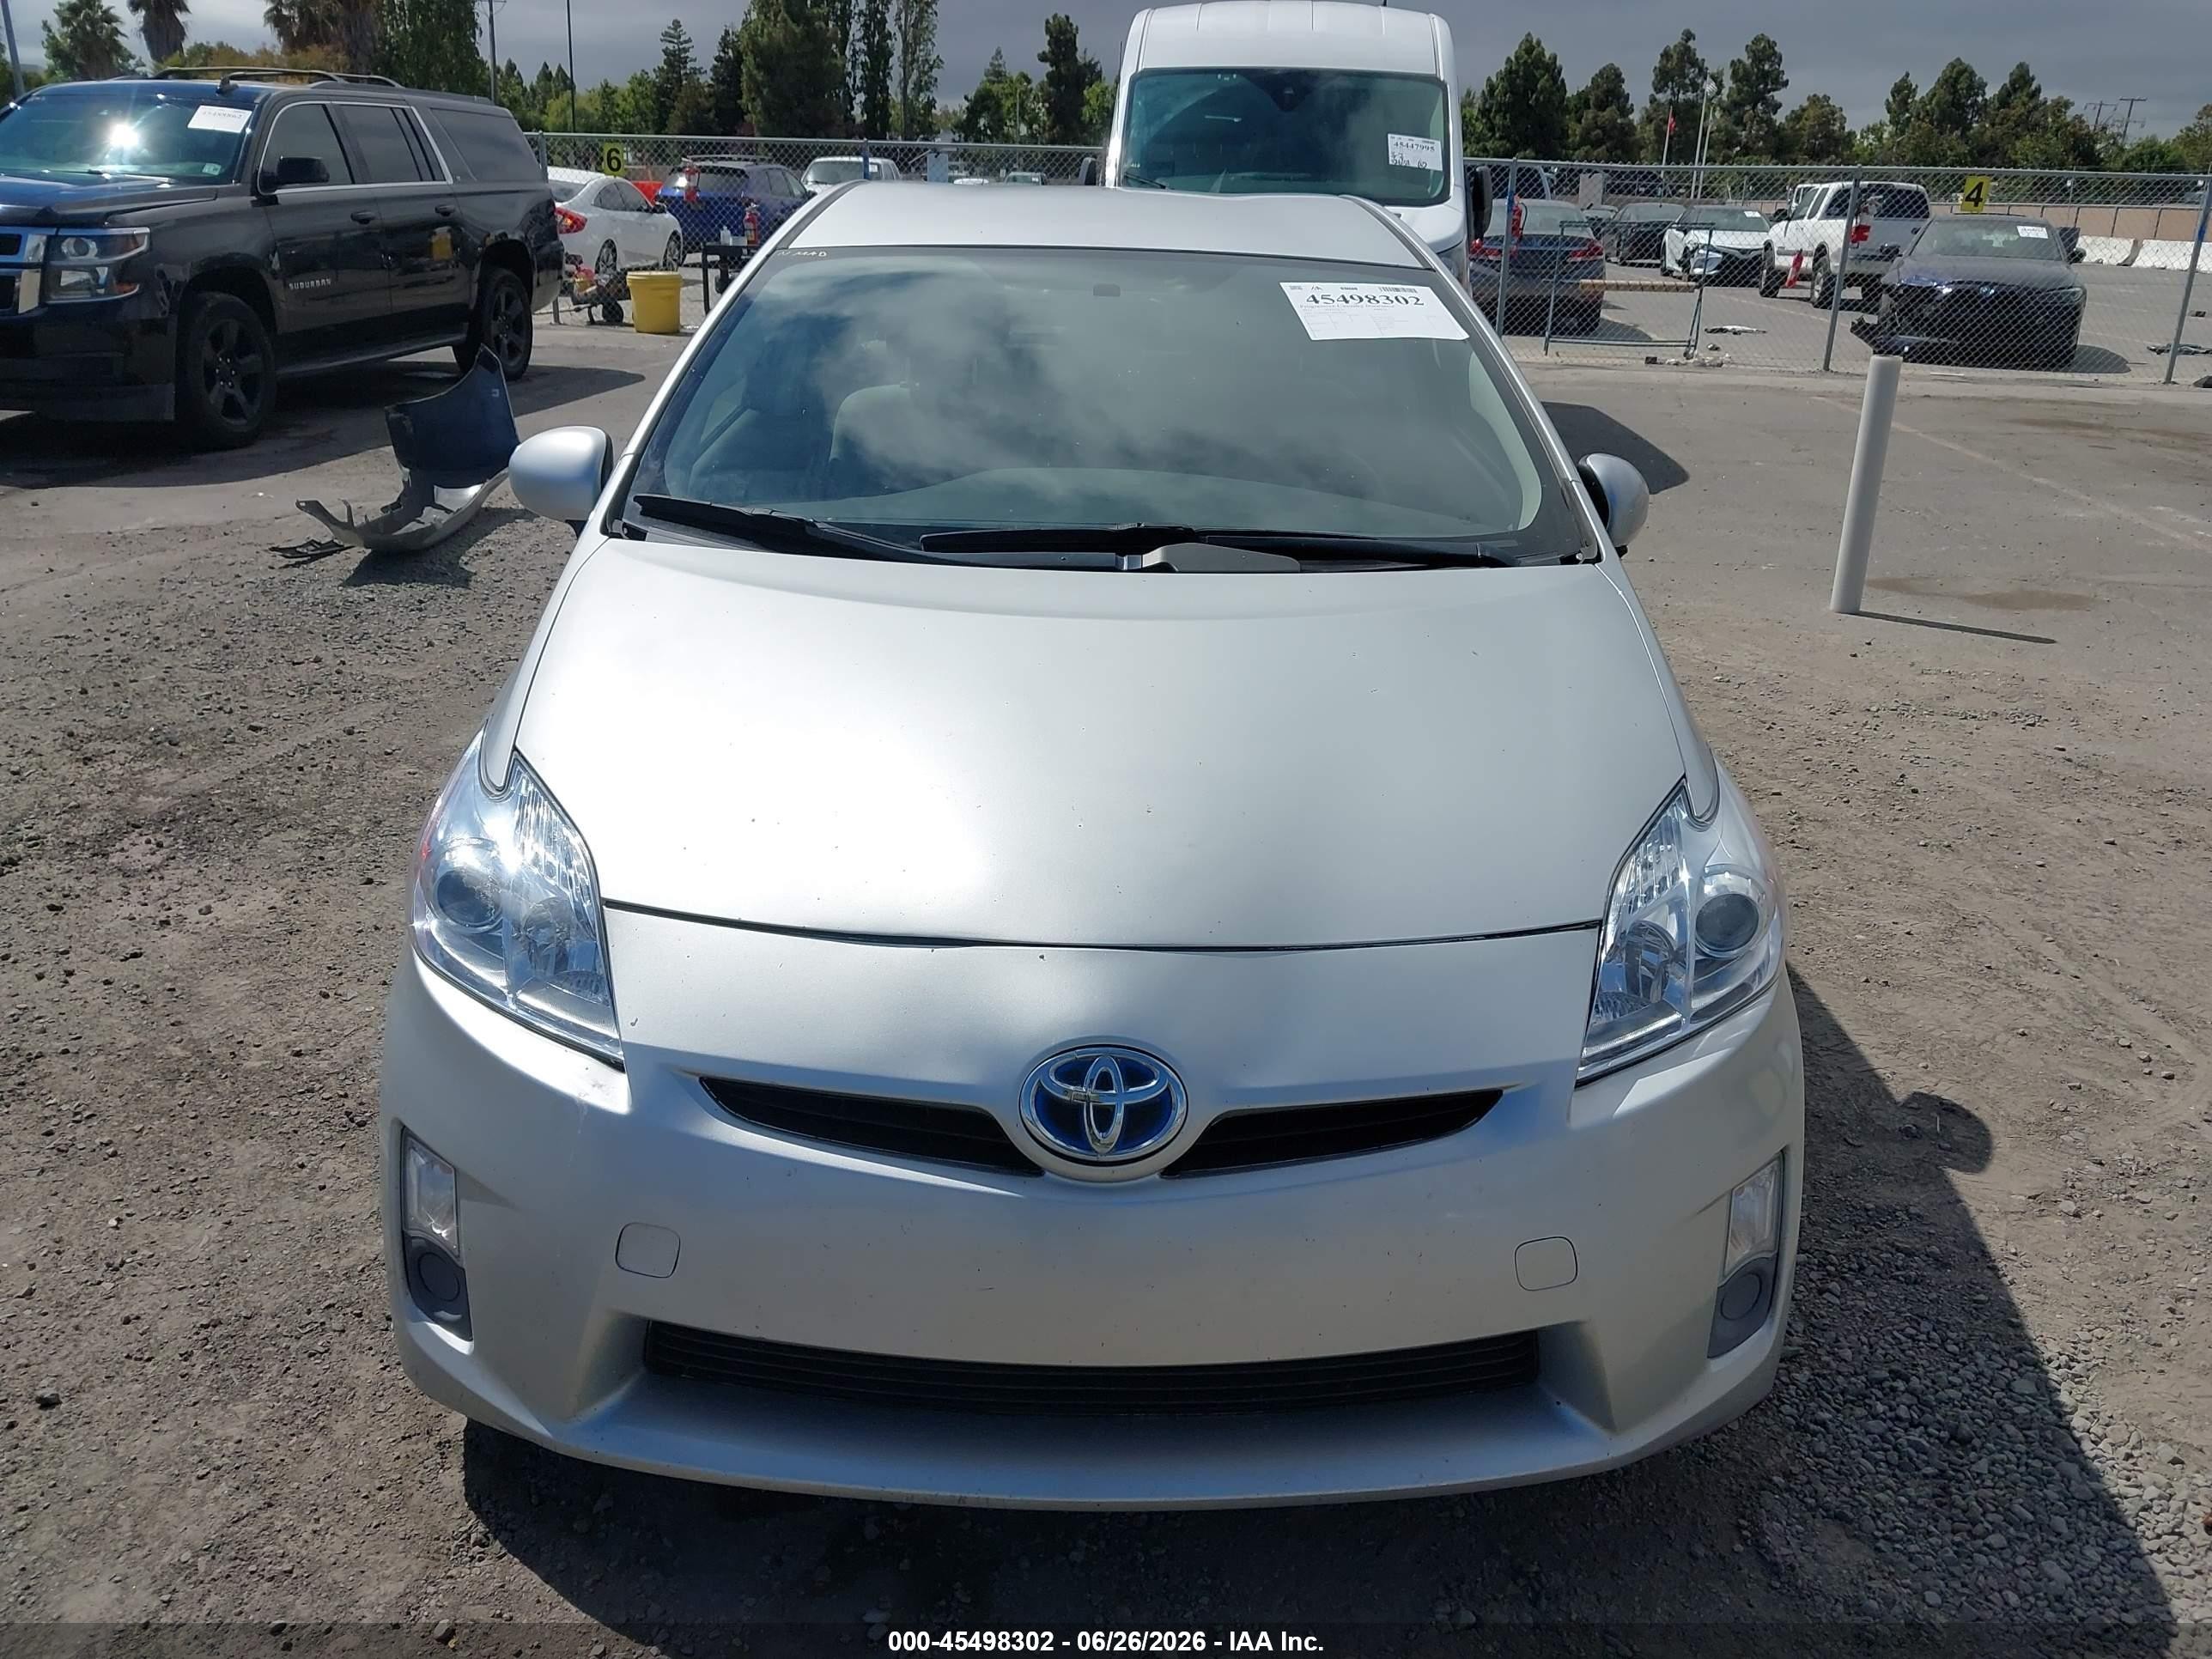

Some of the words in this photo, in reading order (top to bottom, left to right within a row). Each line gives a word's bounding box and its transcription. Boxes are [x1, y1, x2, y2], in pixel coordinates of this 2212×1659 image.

[606, 148, 621, 172] 6
[1965, 181, 1984, 207] 4
[1306, 294, 1425, 307] 45498302
